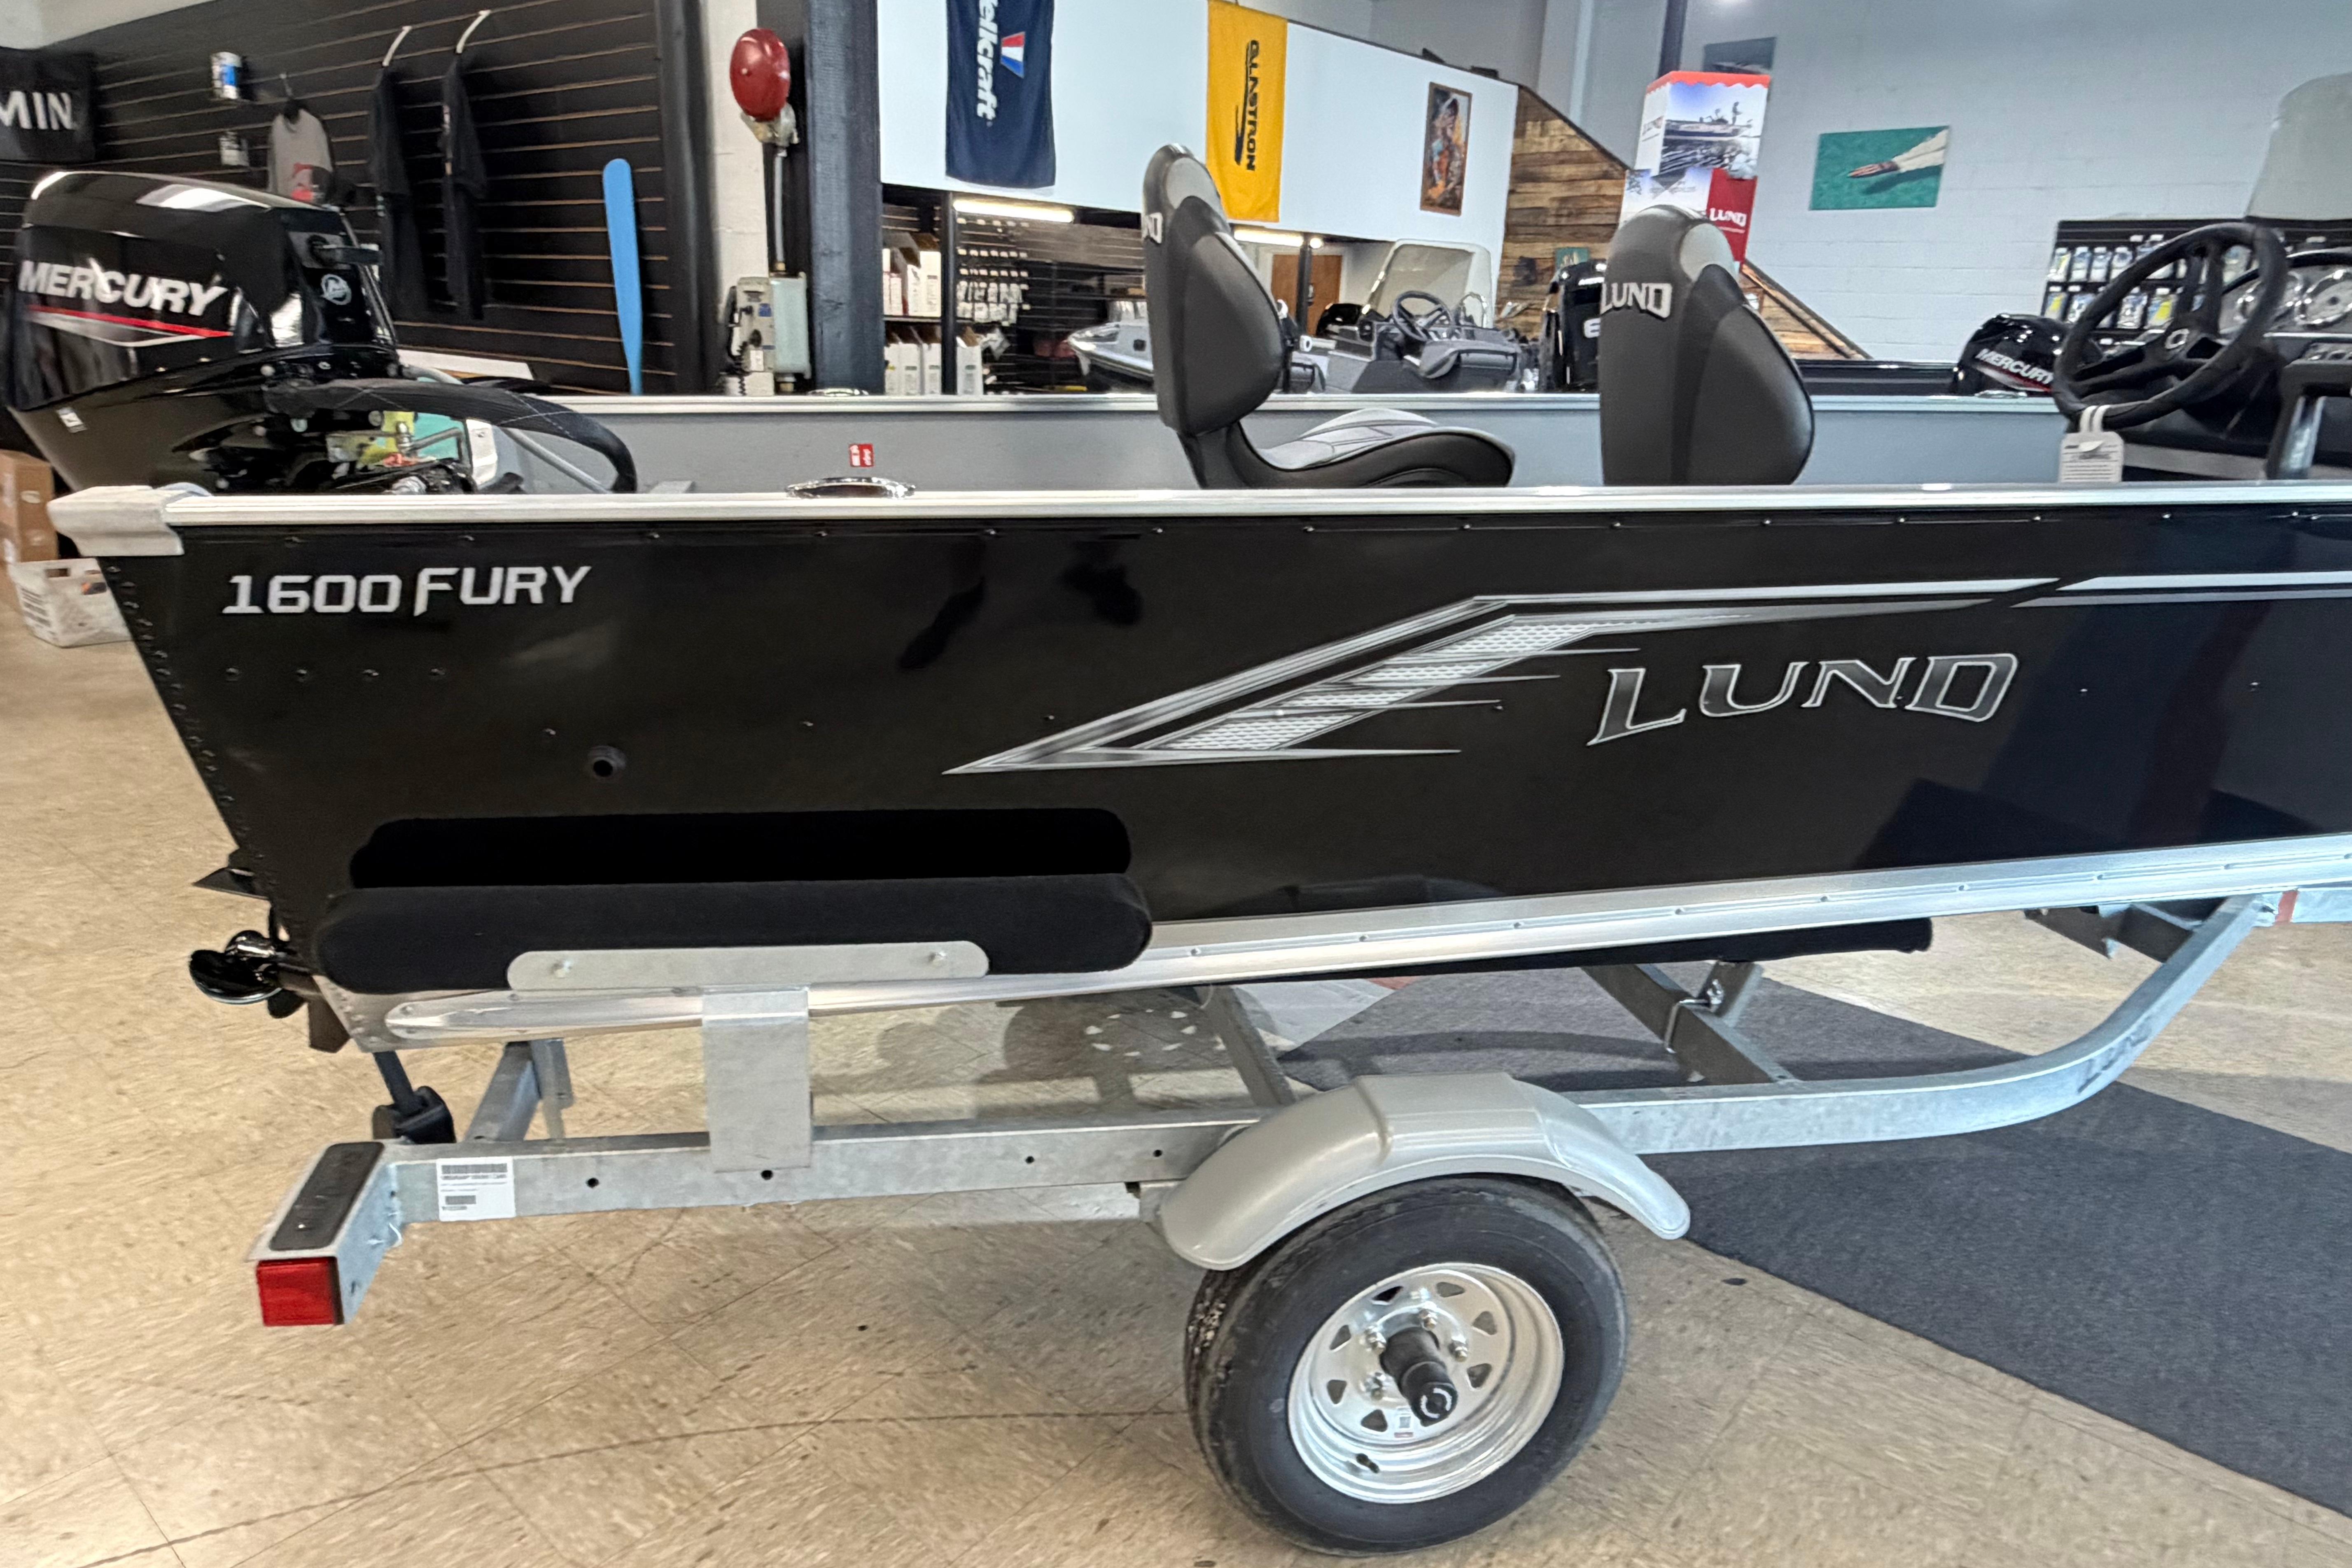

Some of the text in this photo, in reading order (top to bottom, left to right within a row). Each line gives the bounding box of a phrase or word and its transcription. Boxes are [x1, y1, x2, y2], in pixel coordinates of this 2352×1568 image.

[977, 0, 999, 120] ellcraft
[1710, 208, 1747, 226] LUND
[18, 260, 228, 316] MERCURY
[1600, 283, 1672, 318] LUND
[222, 566, 591, 616] 1600 FURY
[1586, 653, 2018, 746] LUND
